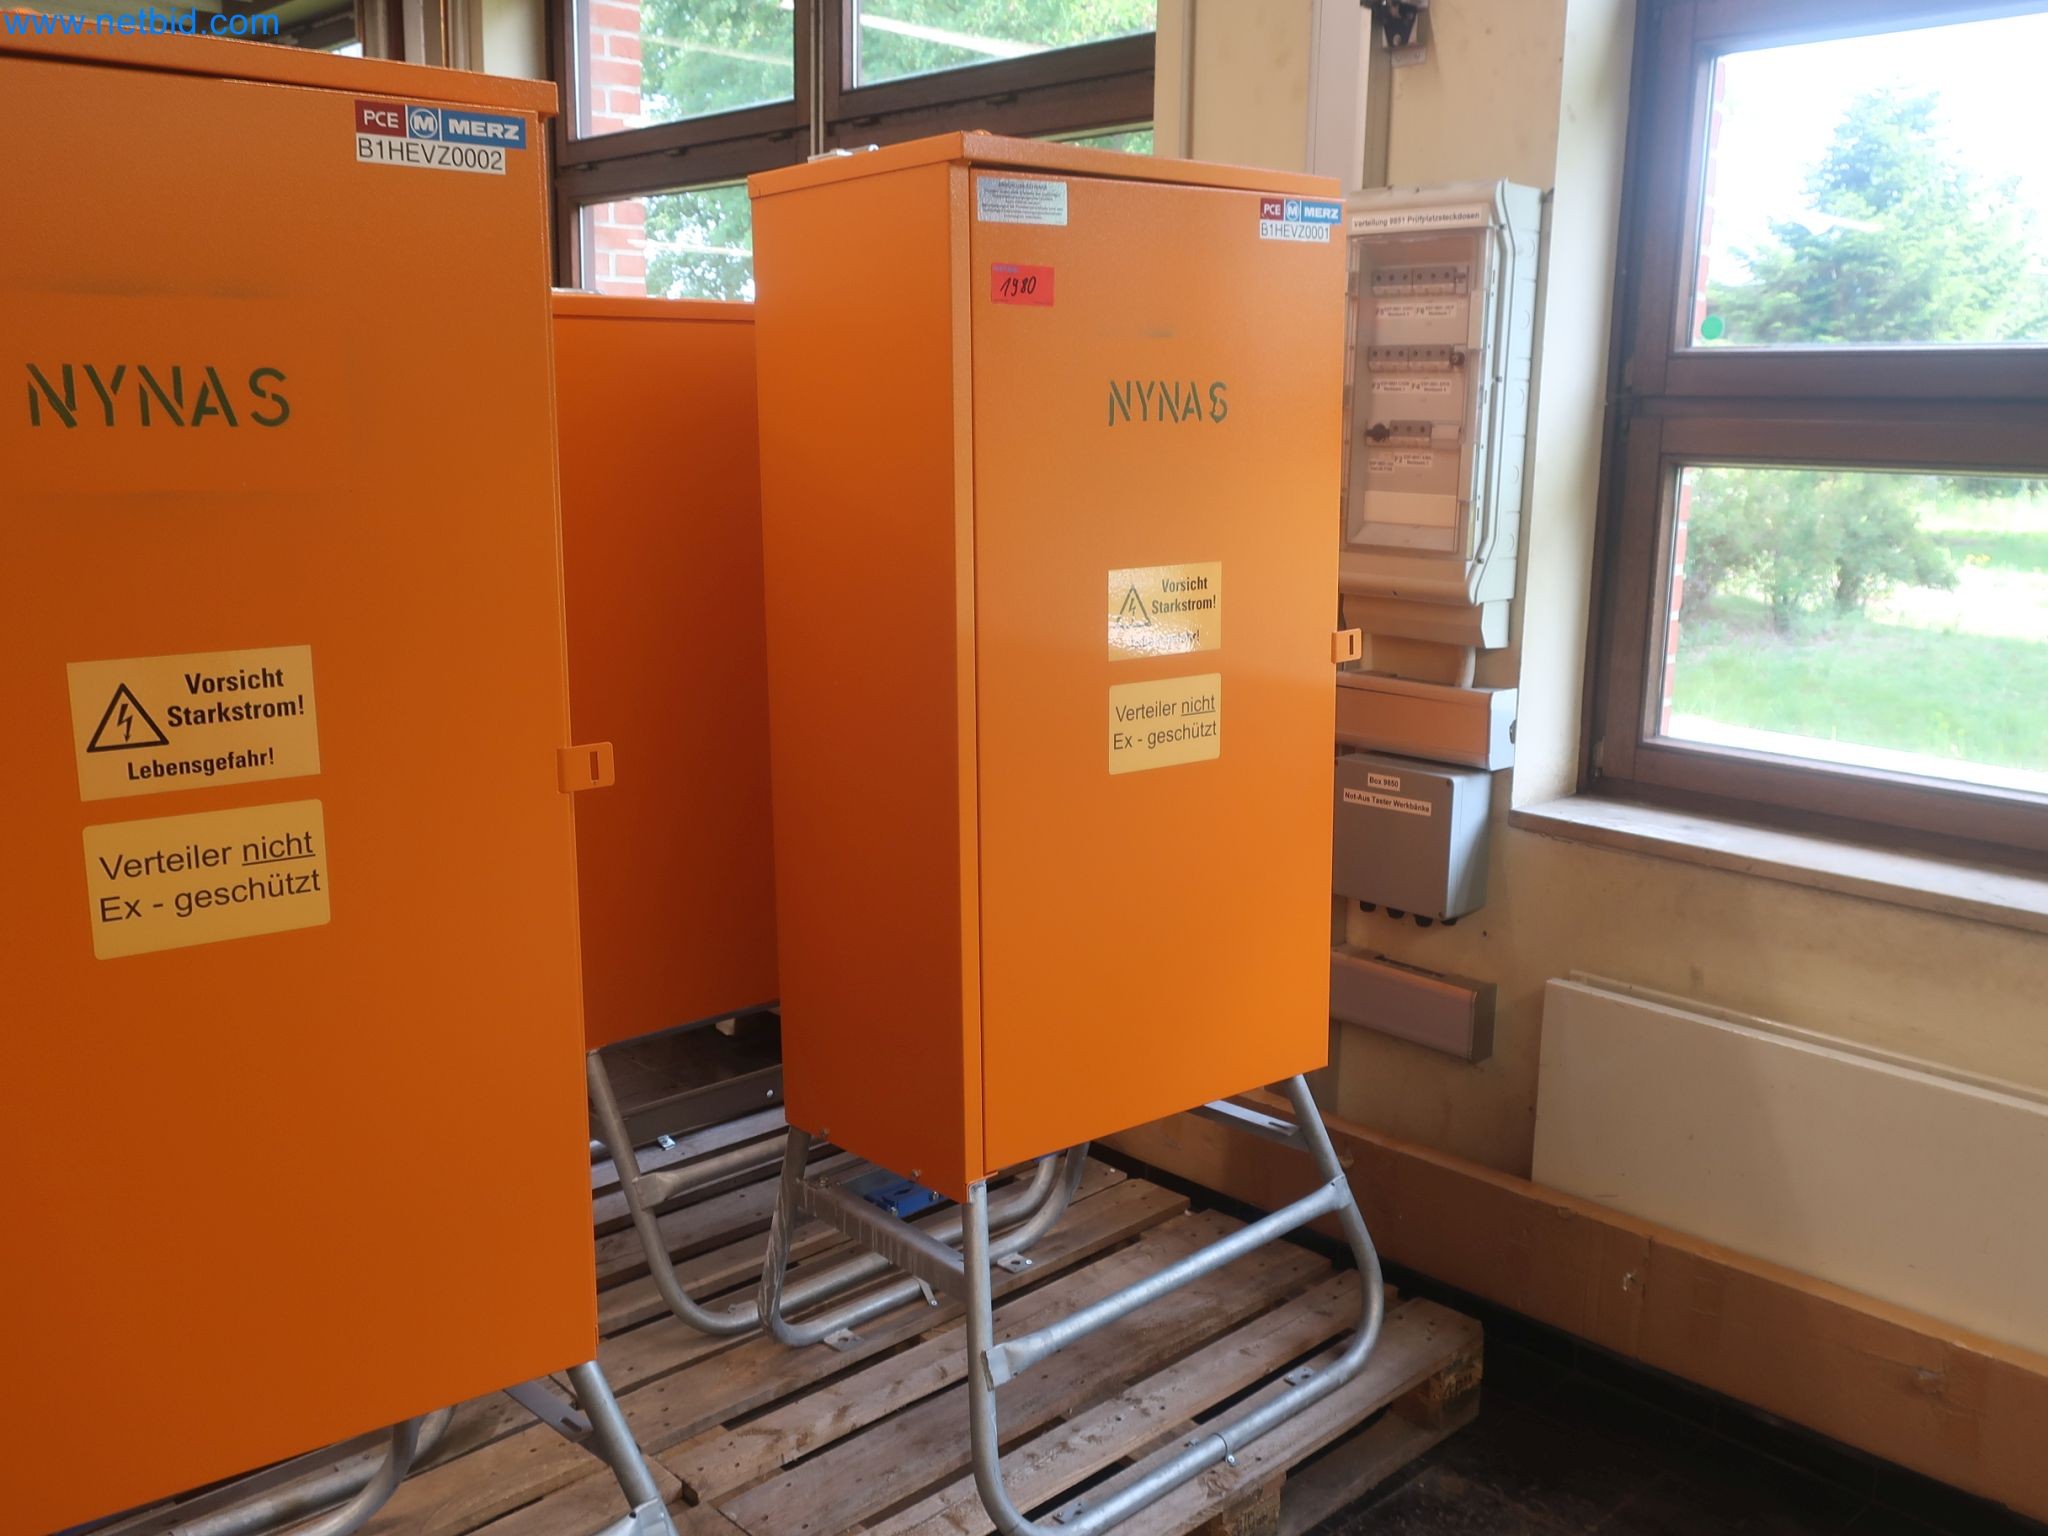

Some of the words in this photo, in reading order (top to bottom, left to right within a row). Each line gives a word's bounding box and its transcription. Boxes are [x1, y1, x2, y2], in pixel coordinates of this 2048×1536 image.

[363, 109, 399, 129] PCE
[449, 118, 519, 141] MERZ
[358, 137, 503, 171] B1HEVZ0002
[1264, 204, 1280, 215] PCE
[1304, 206, 1339, 219] MERZ
[1261, 222, 1329, 240] B1HEVZ0001
[1000, 275, 1037, 297] 1980
[26, 363, 290, 428] NYNAS
[1108, 380, 1228, 426] NYNAS
[1162, 576, 1208, 593] Vorsicht
[1151, 594, 1216, 615] Starkstrom!
[185, 668, 284, 695] Vorsicht
[167, 694, 305, 728] Starkstrom!
[1115, 700, 1177, 722] Verteiler
[1180, 694, 1216, 717] nicht
[1113, 732, 1133, 750] Ex
[1147, 720, 1217, 749] geschützt
[127, 747, 275, 780] Lebensgefahr!
[1372, 796, 1392, 806] Taster
[99, 844, 233, 881] Verteiler
[241, 831, 317, 867] nicht
[100, 896, 143, 923] Ex
[174, 869, 321, 918] geschützt
